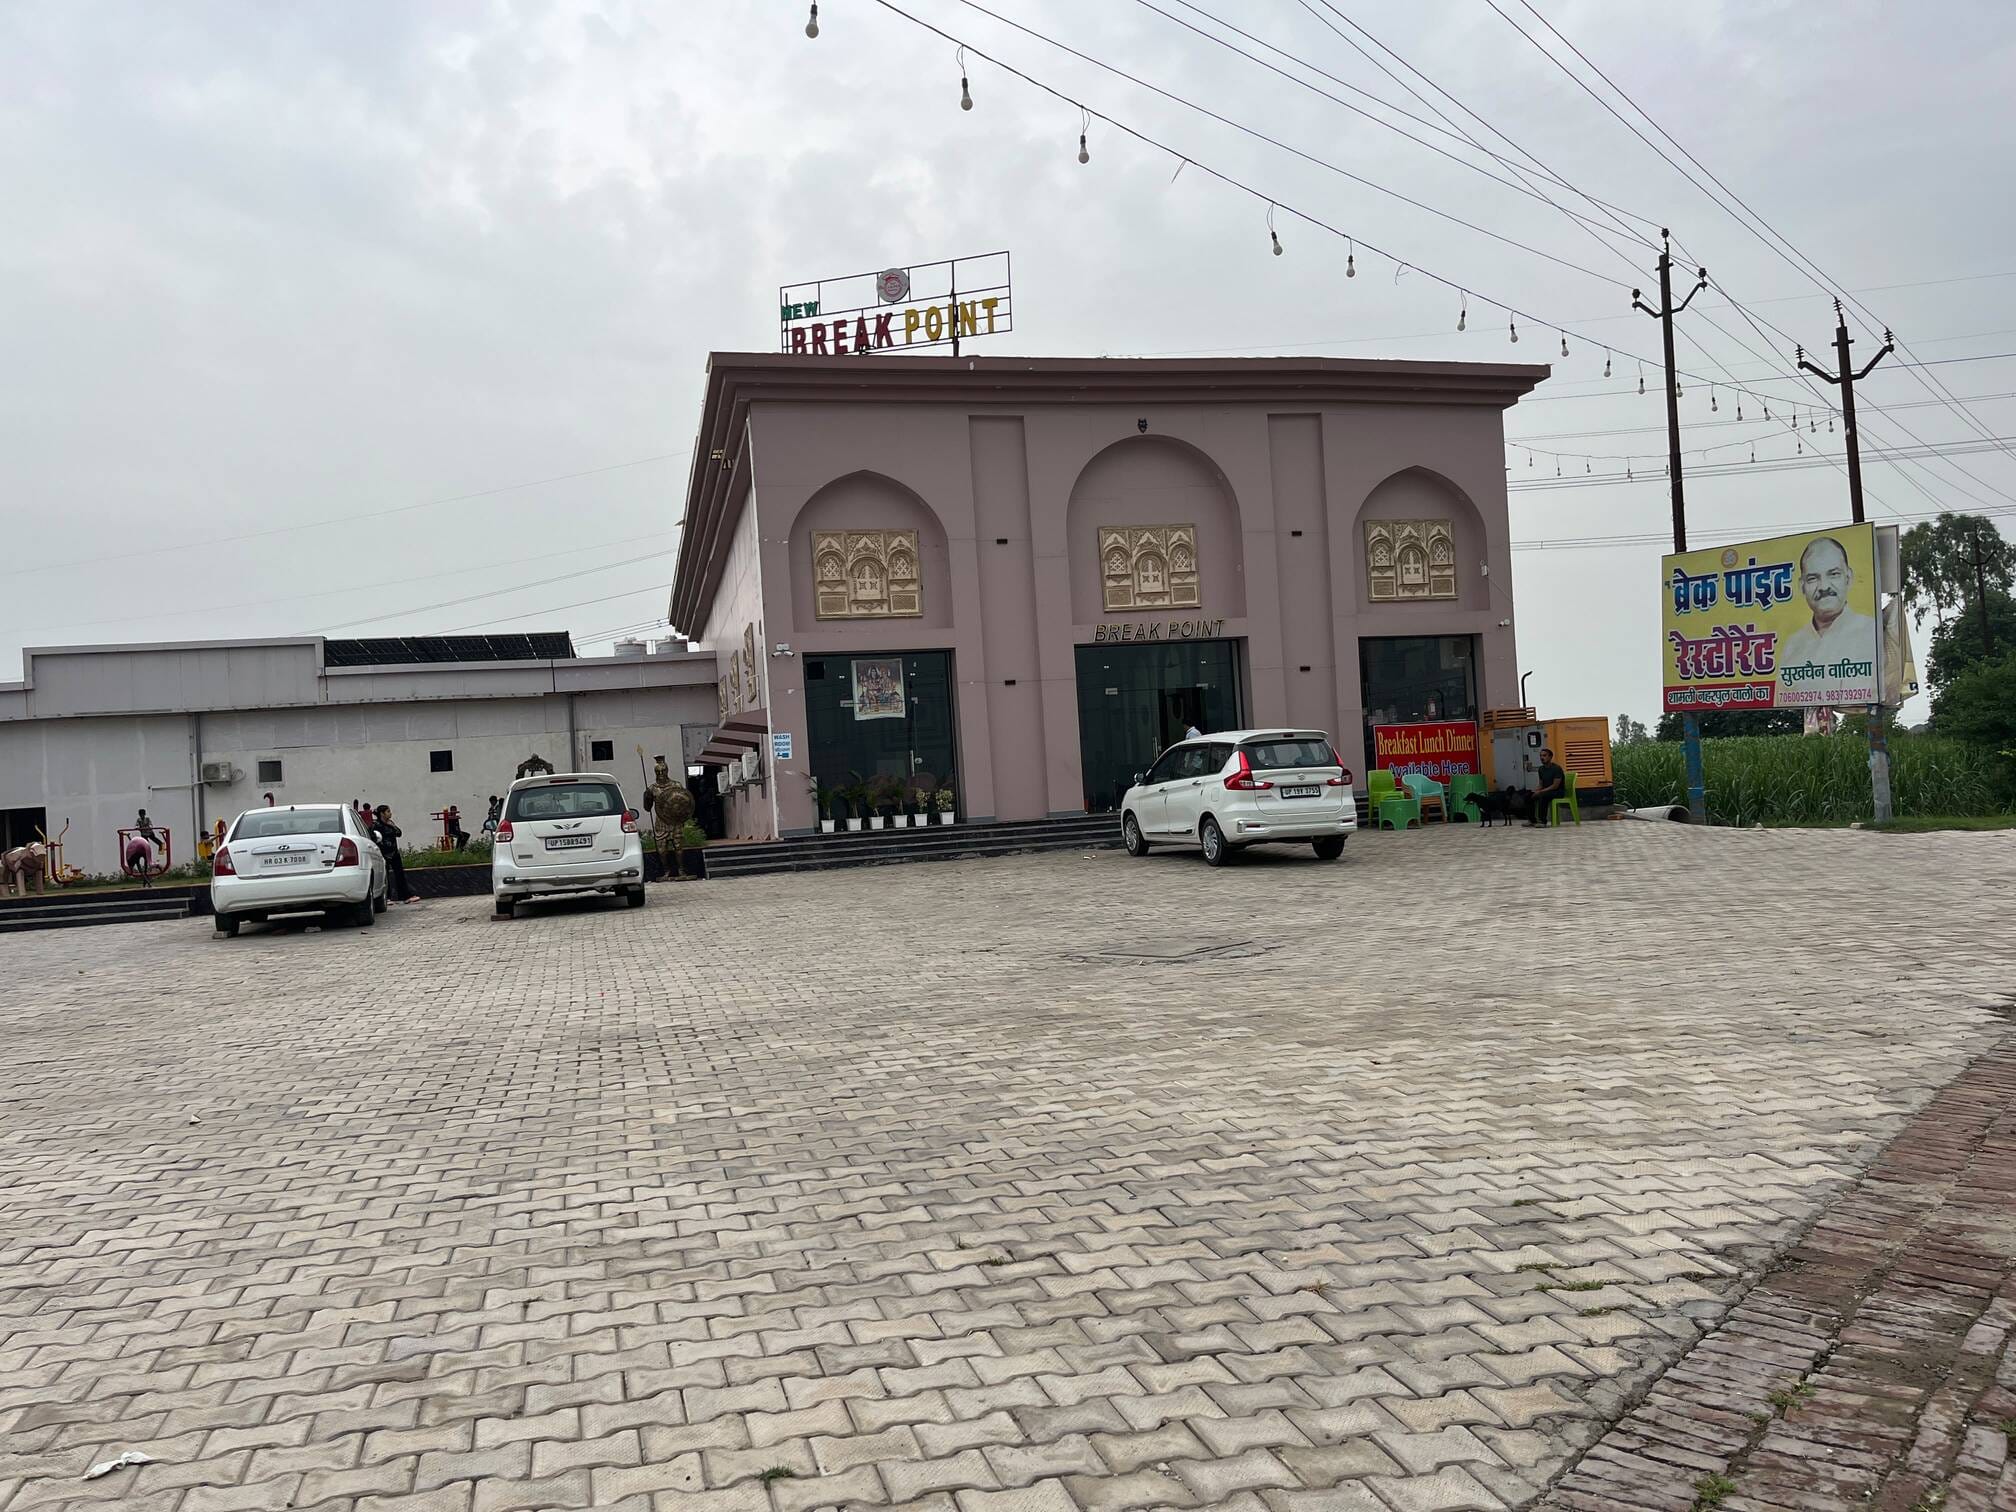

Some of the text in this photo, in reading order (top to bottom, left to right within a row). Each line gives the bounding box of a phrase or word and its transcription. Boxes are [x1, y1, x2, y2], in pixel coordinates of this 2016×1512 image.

[781, 301, 818, 319] NEW
[791, 297, 999, 355] BREAK POINT
[1672, 567, 1719, 615] ब्रेक
[1094, 619, 1225, 642] BREAK POINT
[1780, 658, 1872, 686] सुखचैन वालिया
[1755, 687, 1770, 701] का
[1377, 728, 1475, 755] Breakfast Lunch Dinner
[1389, 760, 1469, 778] Available Here
